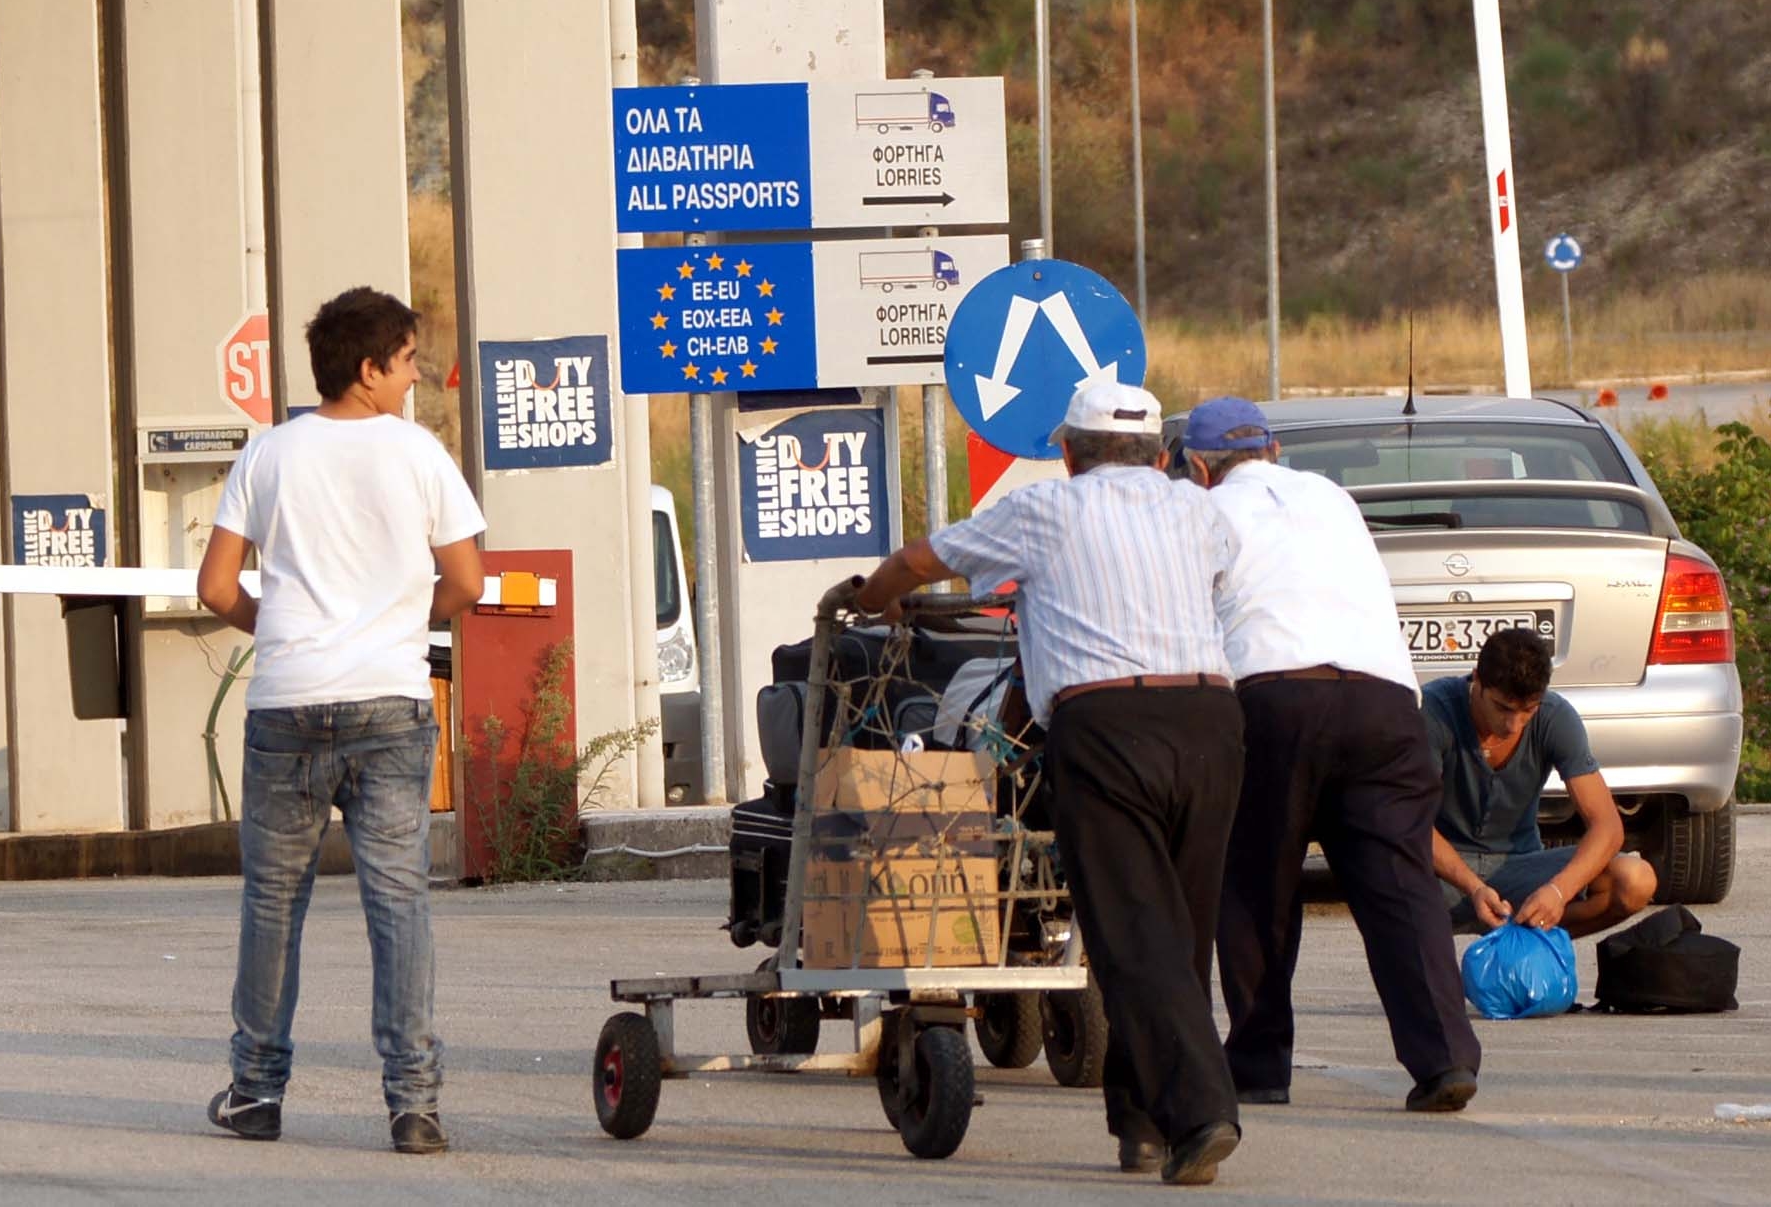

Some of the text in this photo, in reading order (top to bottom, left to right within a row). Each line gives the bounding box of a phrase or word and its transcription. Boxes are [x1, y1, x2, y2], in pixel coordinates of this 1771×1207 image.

[626, 107, 703, 135] ΟΛΑ ΤΑ
[627, 144, 754, 173] ΔΙΑΒΑΤΗΡΙΑ
[872, 145, 944, 164] ΦΟΡΤΗΓΑ
[876, 167, 942, 187] LORRIES
[628, 181, 799, 211] ALL PASSPORTS
[692, 281, 740, 301] ΕΕ-EU
[682, 309, 752, 329] ΕΟΧ-EEA
[876, 303, 948, 323] ΦΟΡΤΗΓΑ
[687, 336, 749, 356] CH-ΕΛΒ
[880, 326, 946, 346] LORRIES
[228, 340, 272, 400] ST
[495, 360, 517, 449] HELLENIC
[516, 386, 595, 423] FREE
[518, 421, 596, 448] SHOPS
[755, 435, 780, 538] HELLENIC
[779, 466, 870, 508] FREE
[780, 506, 871, 537] SHOPS
[23, 510, 38, 565] ELLENIC
[39, 529, 94, 556] FREE
